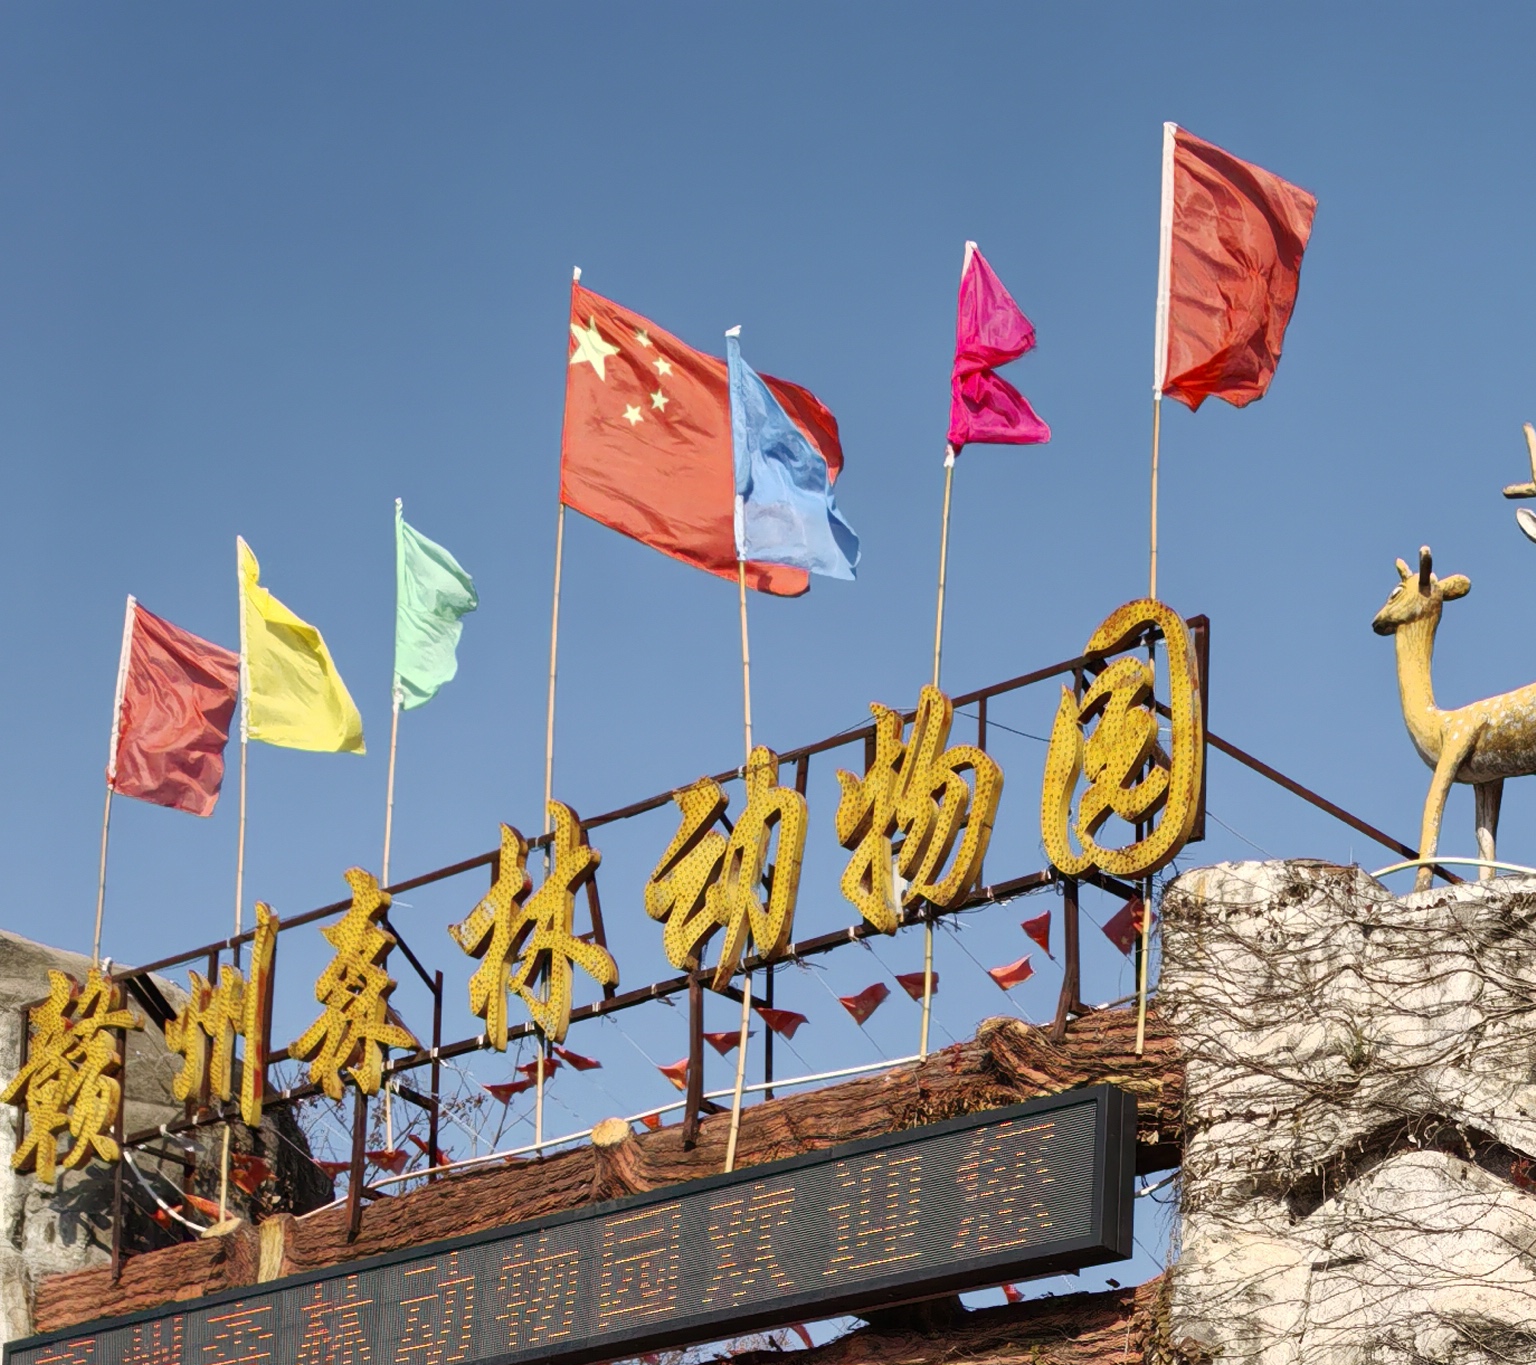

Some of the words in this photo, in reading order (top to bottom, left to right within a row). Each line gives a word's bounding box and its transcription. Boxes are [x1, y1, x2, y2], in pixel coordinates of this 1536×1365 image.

[3, 598, 1204, 1183] 赣州森林动物园
